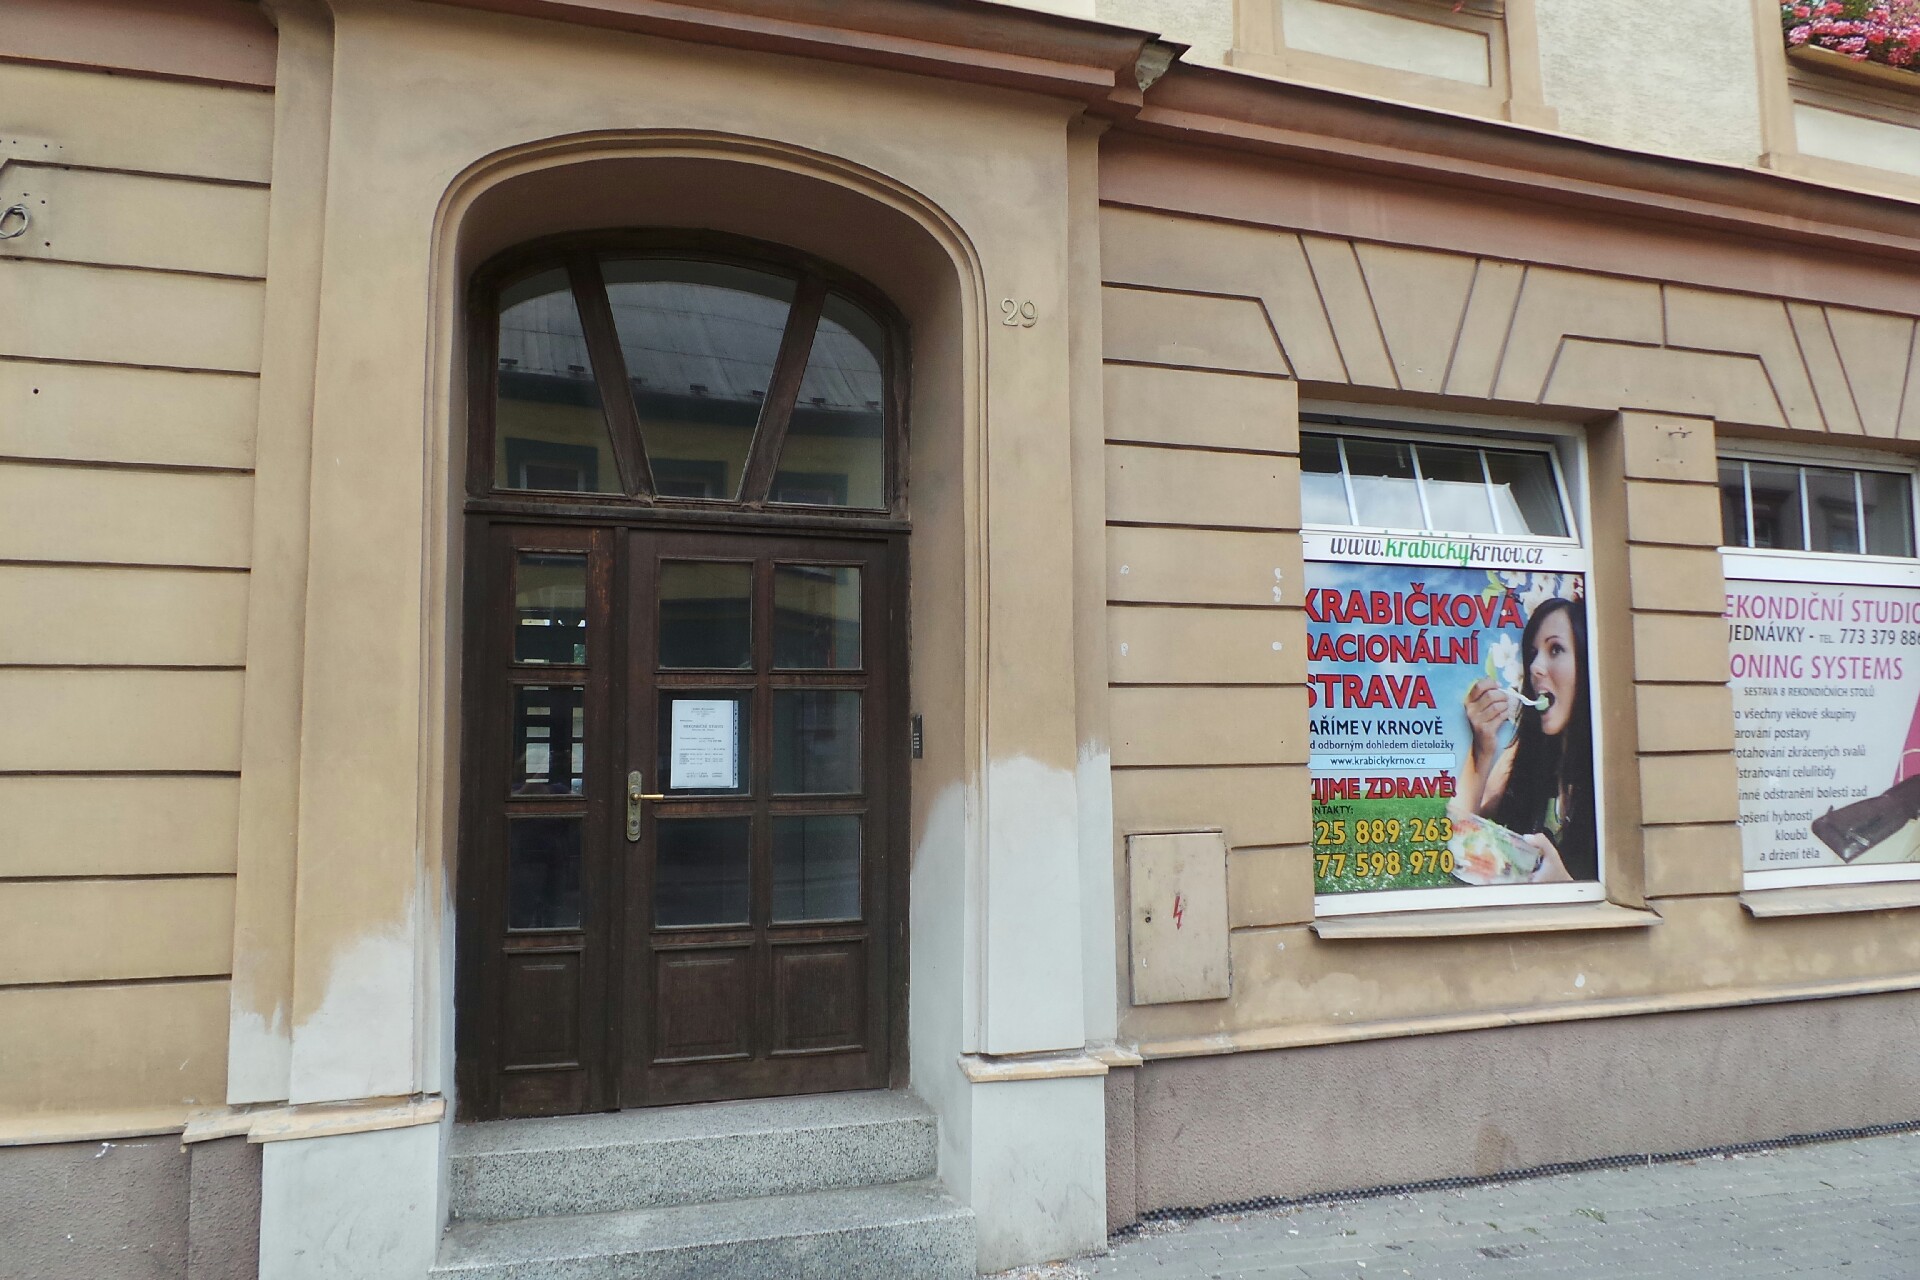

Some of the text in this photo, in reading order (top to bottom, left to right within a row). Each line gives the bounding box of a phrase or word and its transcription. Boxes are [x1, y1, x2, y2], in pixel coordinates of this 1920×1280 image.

[1000, 298, 1038, 328] 29
[1840, 628, 1865, 644] 773
[1870, 629, 1895, 645] 379
[1730, 654, 1903, 680] ONING SYSTEMS
[1744, 687, 1778, 697] SESTAVA
[1744, 708, 1782, 722] všechny
[1785, 708, 1818, 719] věkové
[1821, 708, 1856, 722] skupiny
[1361, 720, 1372, 735] V
[1377, 716, 1443, 735] KRNOVĚ
[1774, 728, 1810, 740] postavy
[1318, 740, 1363, 751] odborným
[1366, 740, 1408, 749] dohledem
[1411, 740, 1454, 751] dietoložky
[1788, 745, 1840, 759] zkrácených
[1843, 744, 1866, 756] svalů
[1330, 756, 1425, 767] www.krabickykrnov.cz
[1793, 765, 1836, 779] celulitidy
[1365, 770, 1457, 799] ZDRAVĚ!
[1817, 786, 1848, 798] bolesti
[1851, 785, 1867, 797] zad
[1312, 805, 1353, 816] NTAKTY:
[1773, 809, 1813, 825] hybnosti
[1313, 817, 1453, 845] 25 889 263
[1775, 828, 1807, 840] kloubů
[1760, 848, 1820, 861] a držení těla
[1355, 851, 1401, 877] 598
[1409, 849, 1454, 874] 970
